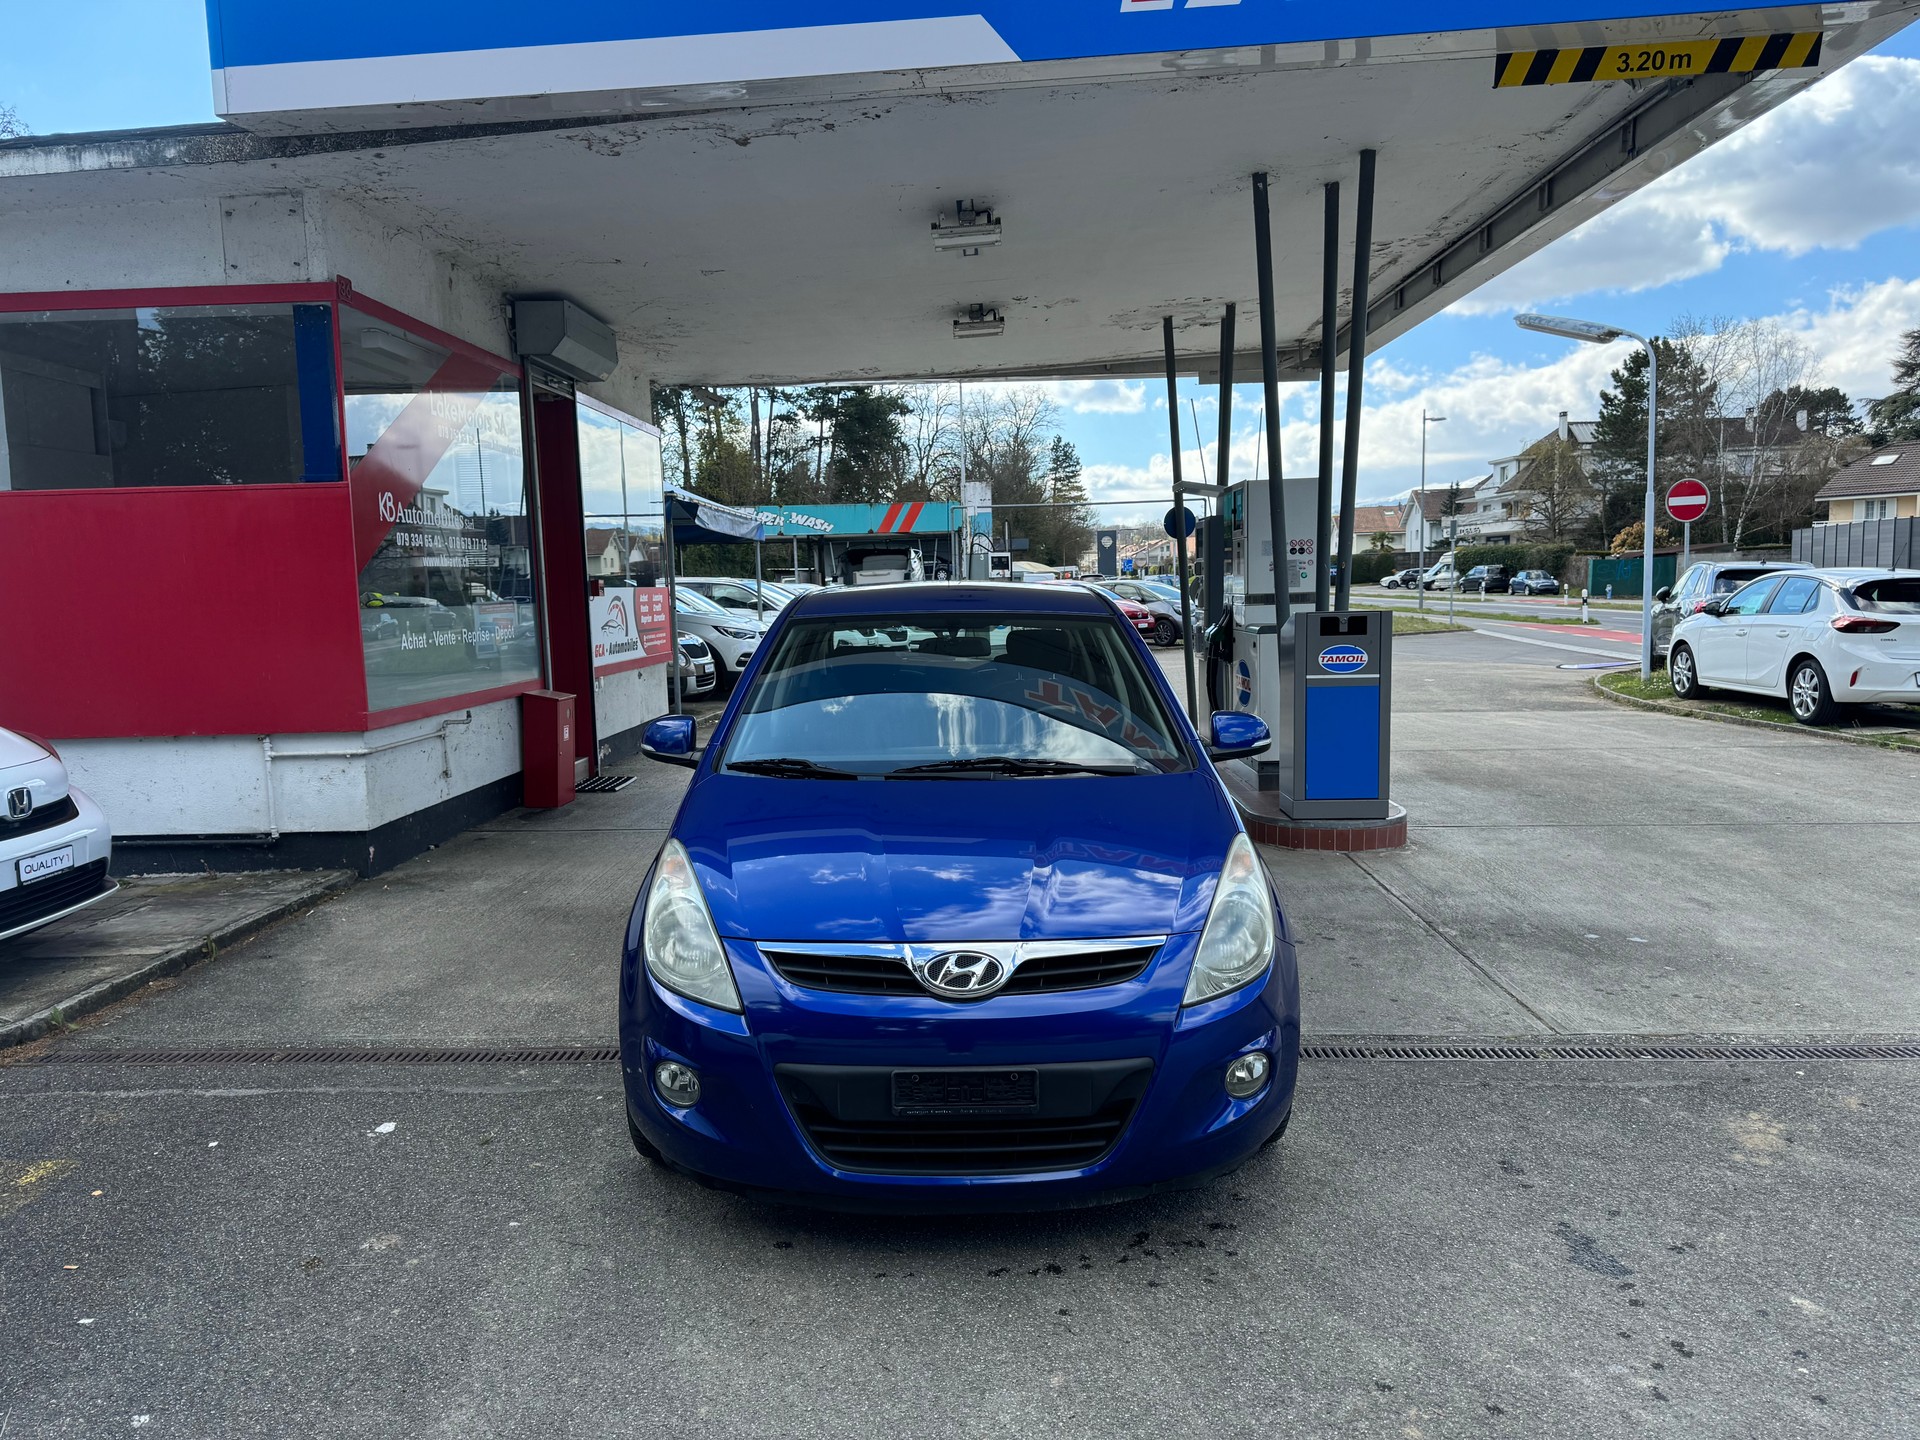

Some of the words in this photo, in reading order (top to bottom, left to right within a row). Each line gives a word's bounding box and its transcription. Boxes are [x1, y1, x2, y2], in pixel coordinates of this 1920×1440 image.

[1616, 50, 1666, 73] 3.20
[1669, 52, 1692, 70] m
[378, 491, 396, 523] KB
[396, 501, 464, 530] Automobiles
[754, 510, 785, 527] UPER
[790, 512, 834, 533] WASH
[410, 533, 423, 547] 334
[424, 534, 433, 548] 65
[401, 632, 428, 651] Achat
[432, 630, 457, 647] Vente
[462, 627, 490, 646] Reprise
[608, 637, 639, 656] Automobiles
[1320, 654, 1367, 663] TAMOIL
